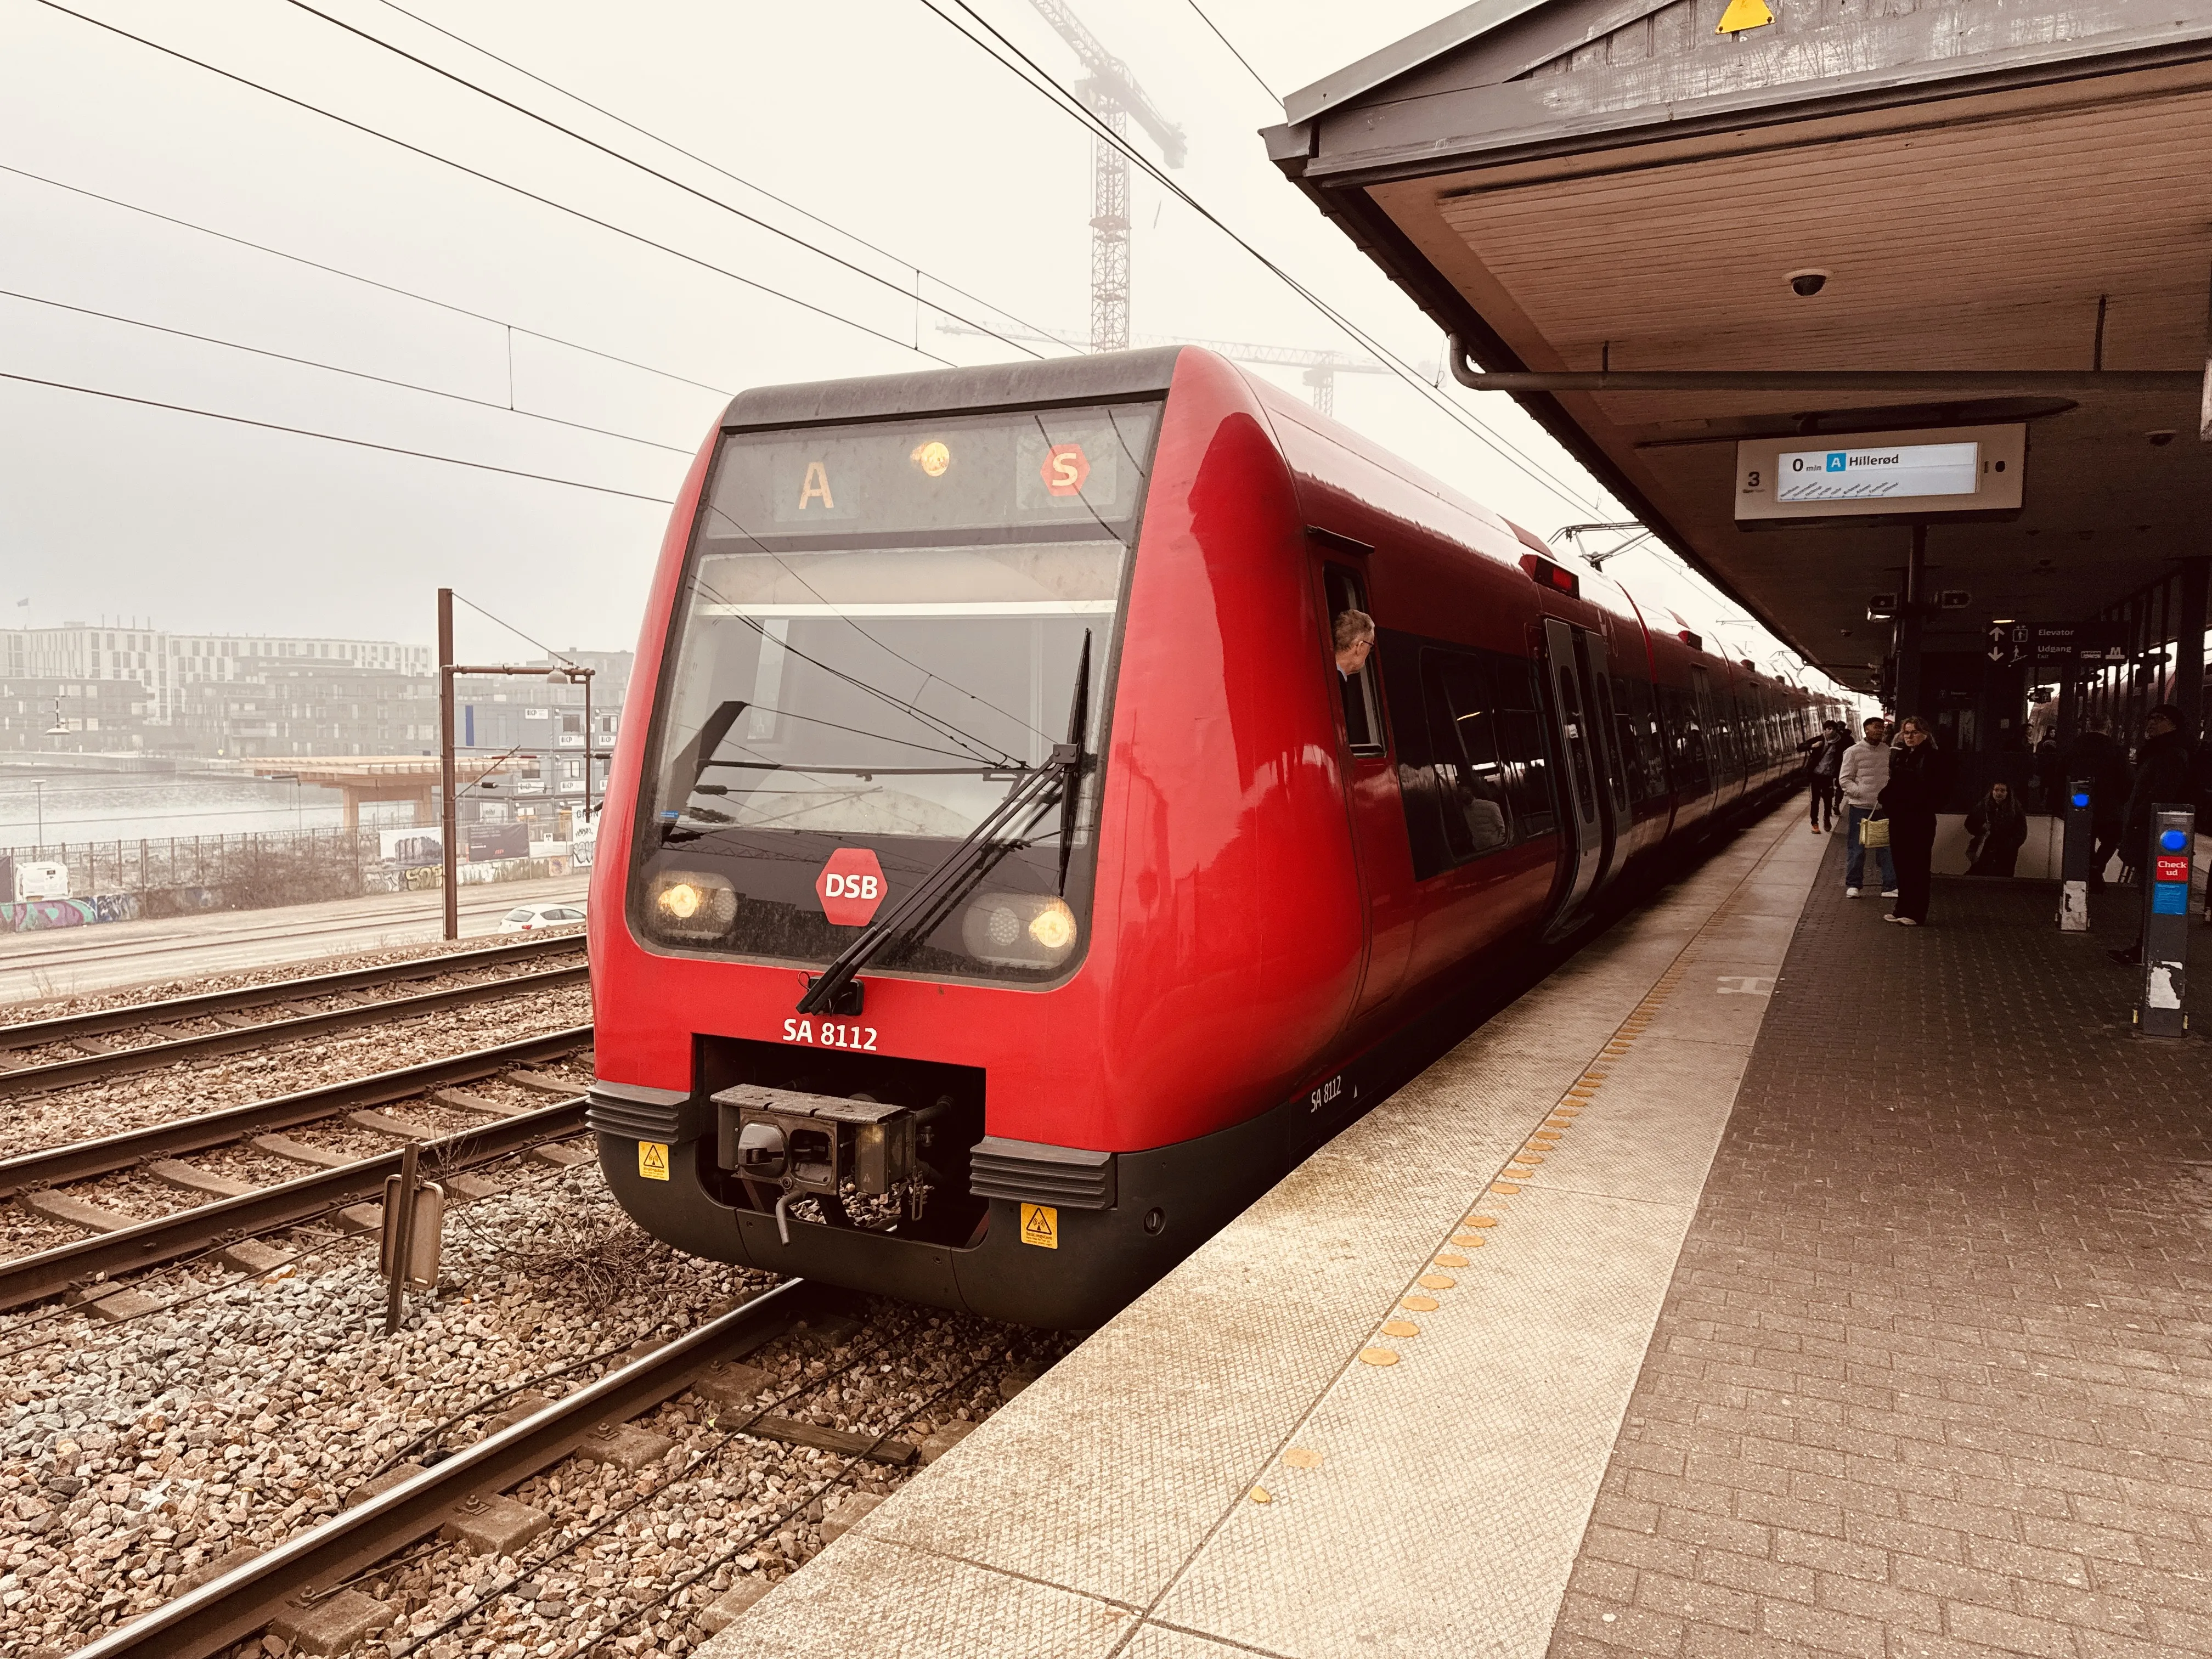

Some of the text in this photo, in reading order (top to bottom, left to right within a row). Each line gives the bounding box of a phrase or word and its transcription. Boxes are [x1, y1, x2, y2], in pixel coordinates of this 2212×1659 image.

[1052, 452, 1078, 487] S
[1748, 471, 1760, 487] 3
[1792, 458, 1804, 472] 0
[1830, 457, 1842, 468] A
[1848, 454, 1899, 466] Hillerød
[798, 461, 834, 510] A
[825, 873, 878, 900] DSB
[783, 1018, 877, 1052] SA 8112
[1311, 1075, 1341, 1113] SA 8112
